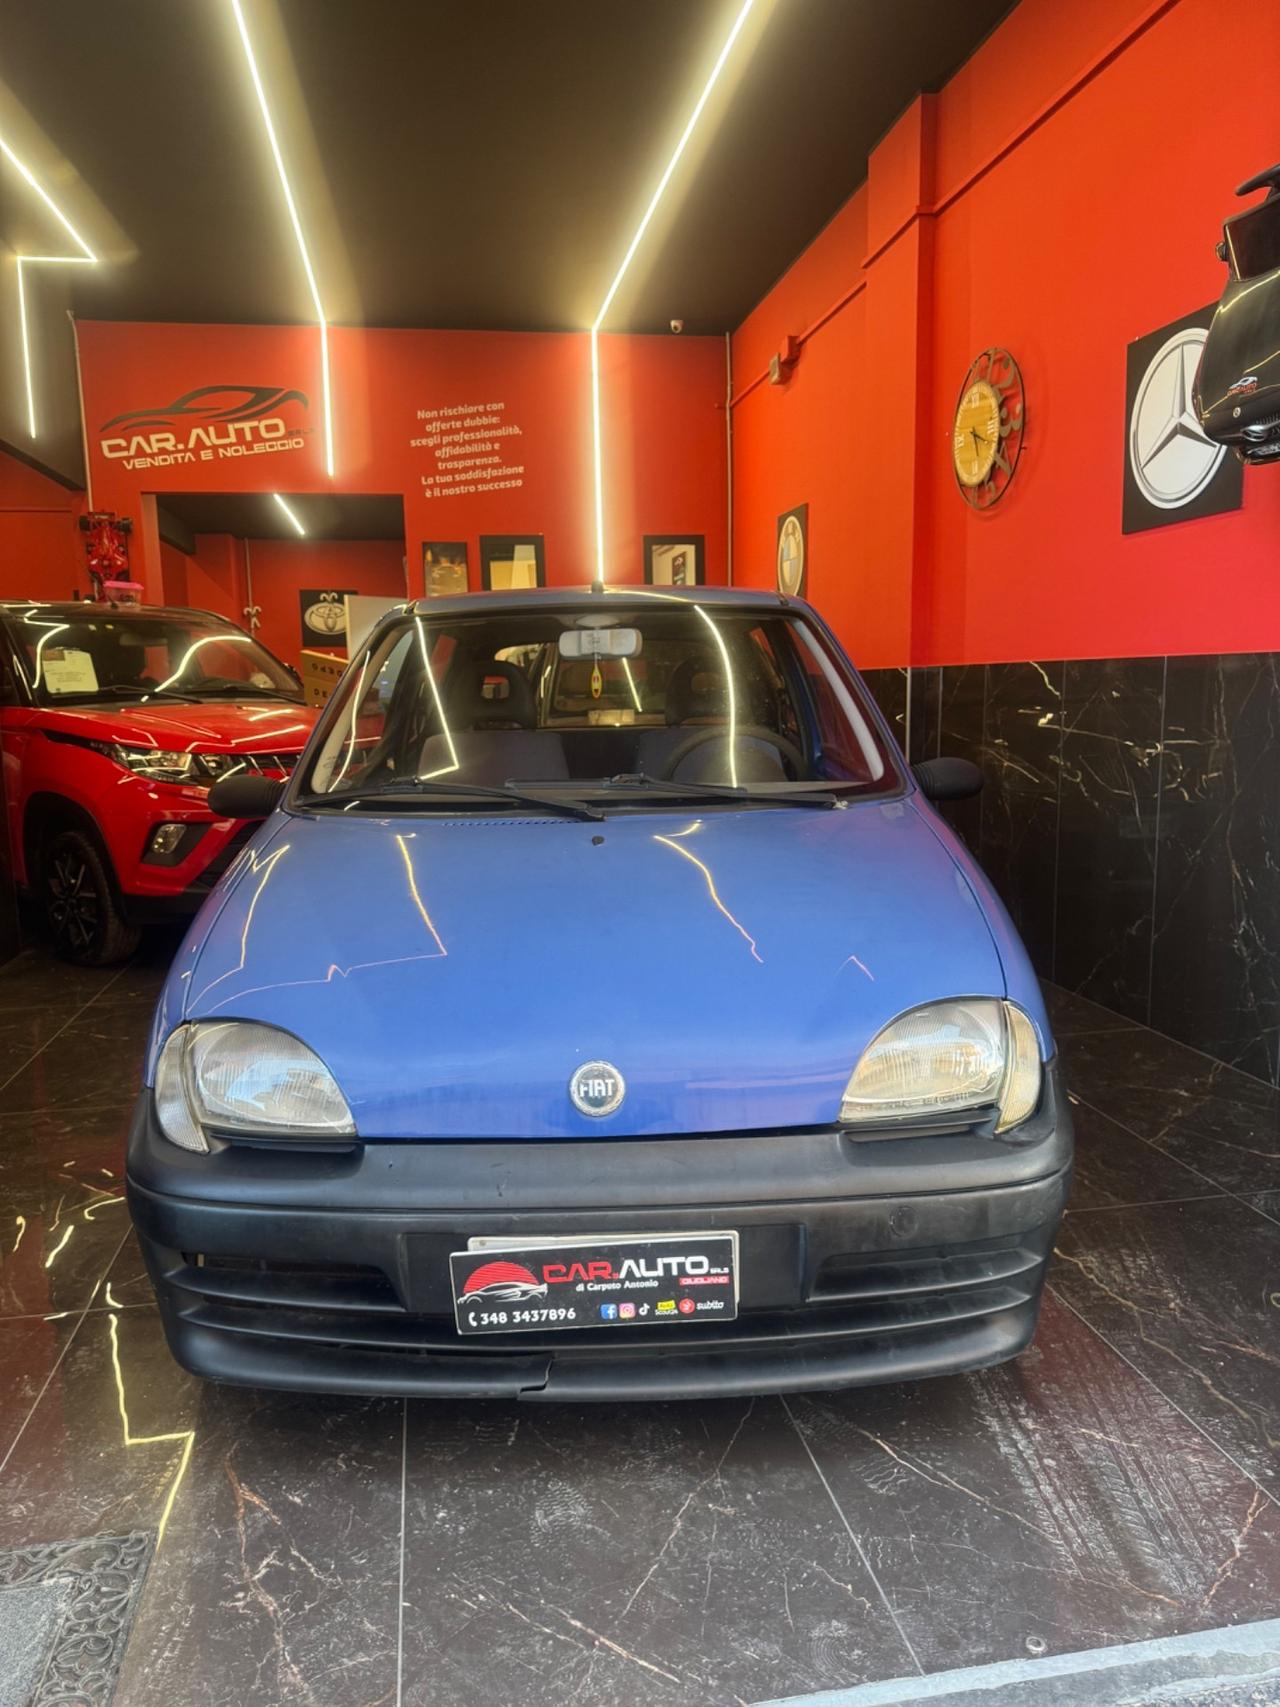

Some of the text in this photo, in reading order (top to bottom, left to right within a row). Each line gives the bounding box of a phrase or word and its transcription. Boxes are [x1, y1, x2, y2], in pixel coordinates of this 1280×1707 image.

[417, 402, 504, 419] Non rischiare con
[425, 419, 462, 433] offerte
[101, 418, 286, 459] CAR.AUTO
[410, 435, 441, 447] scegli
[122, 437, 304, 470] VENDITA E NOLEGGIO
[435, 441, 500, 458] affidabilità e
[437, 455, 502, 470] trasparenza.
[421, 465, 524, 485] La tua soddisfazione
[425, 478, 523, 498] è il nostro successo
[580, 1079, 615, 1097] FIAT
[543, 1255, 710, 1283] CAR.AUTO
[575, 1279, 659, 1293] di Carputo Antonio
[480, 1308, 576, 1325] 348 3437896
